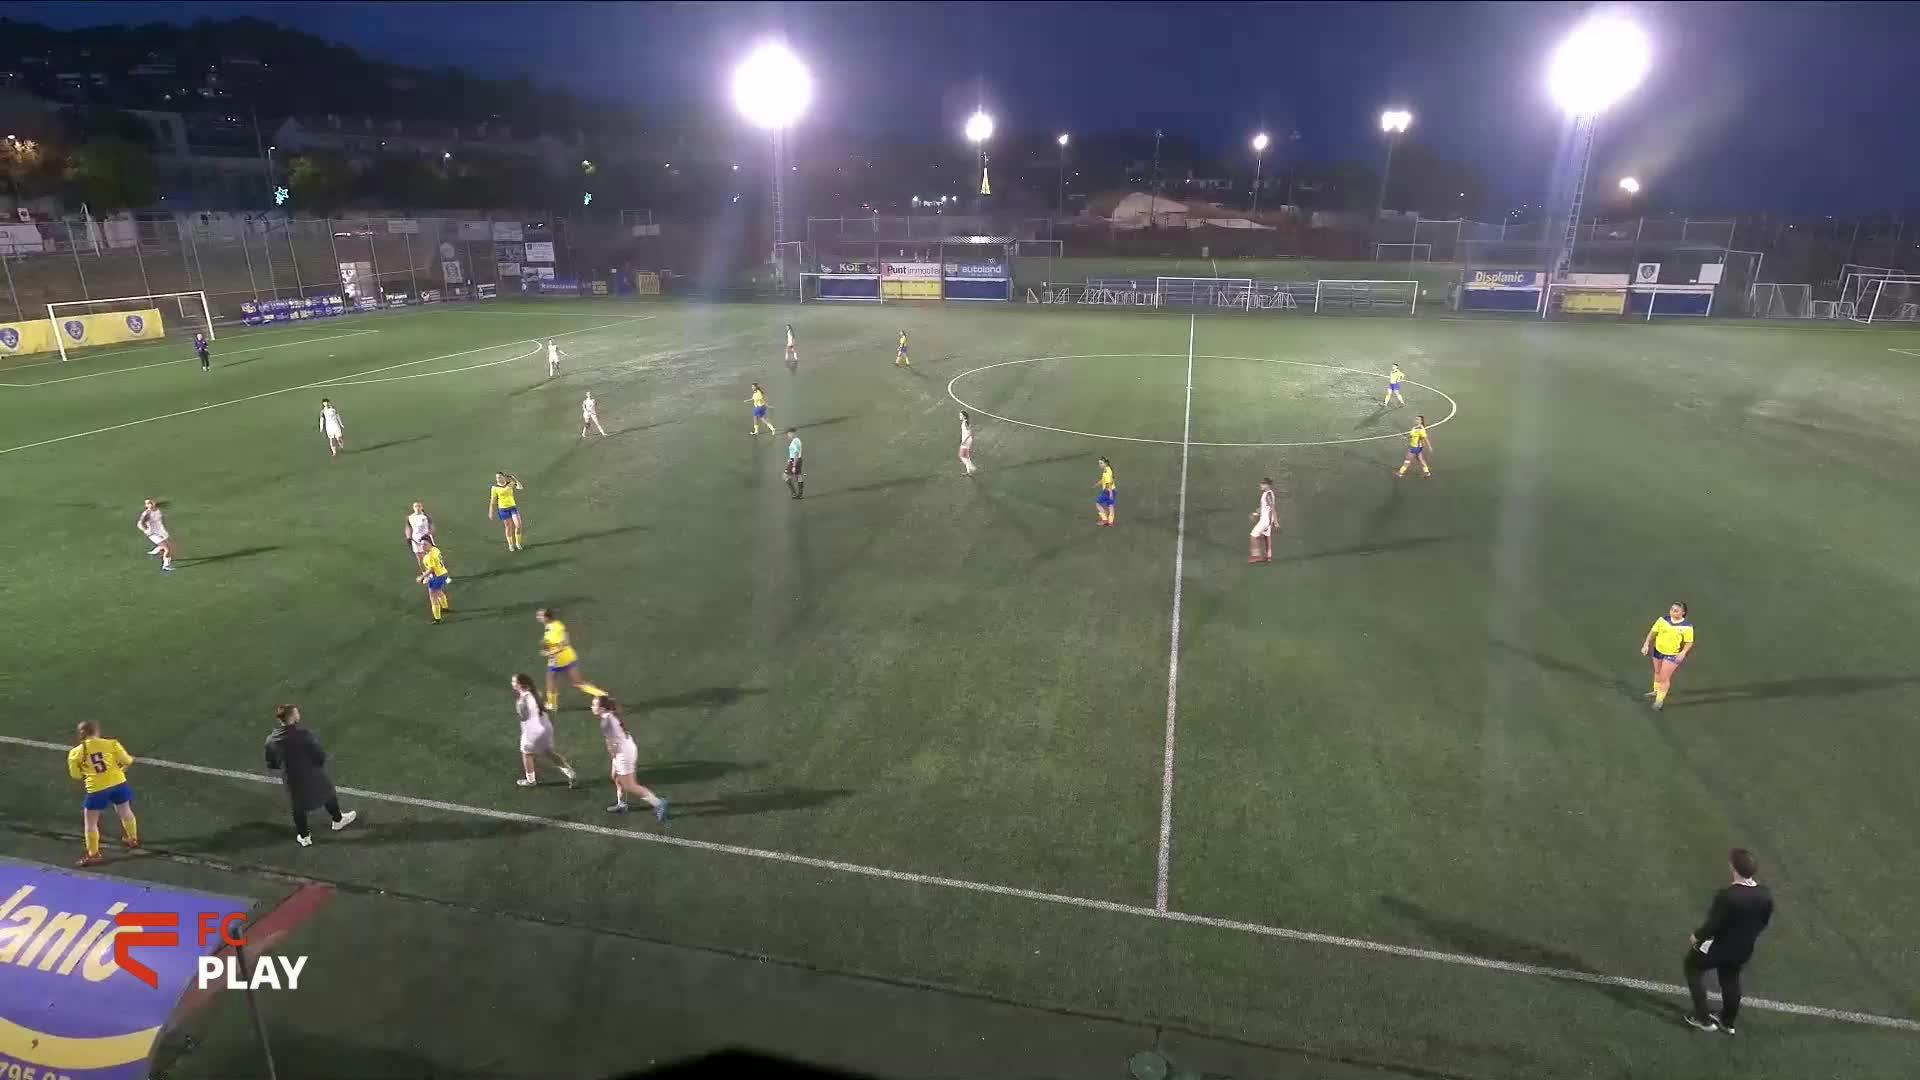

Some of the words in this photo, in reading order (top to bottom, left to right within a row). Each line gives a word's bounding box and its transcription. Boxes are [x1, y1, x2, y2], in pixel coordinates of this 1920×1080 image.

[887, 265, 906, 274] Punt
[962, 265, 1002, 274] autoland
[1475, 271, 1525, 283] Displanic
[90, 752, 108, 773] 5
